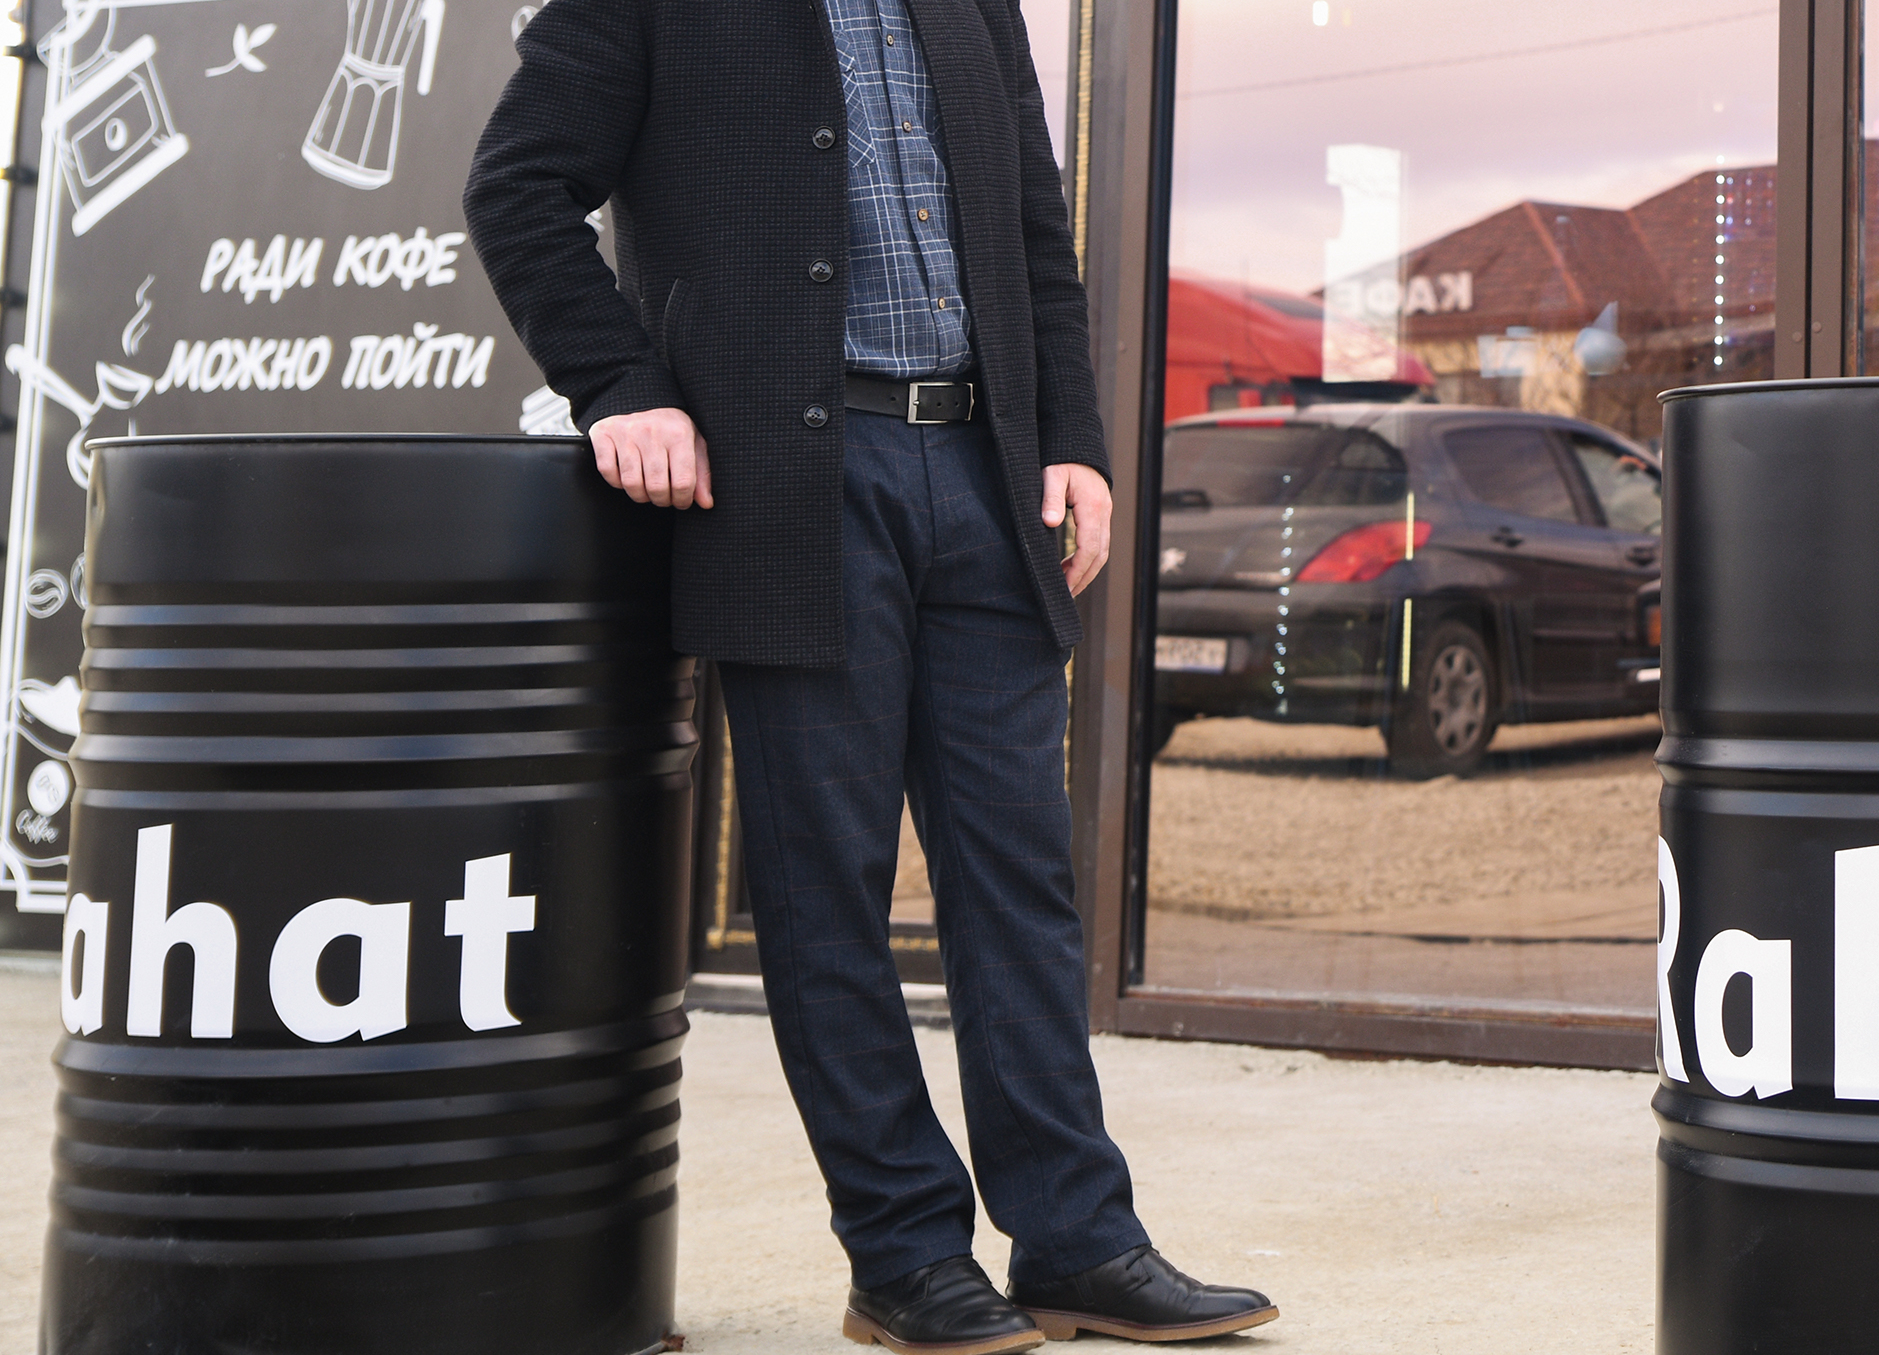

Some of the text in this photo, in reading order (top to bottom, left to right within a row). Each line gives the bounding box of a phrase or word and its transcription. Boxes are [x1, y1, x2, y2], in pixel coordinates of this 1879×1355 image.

[200, 227, 467, 304] РАДИ КОФЕ
[155, 321, 495, 395] МОЖНО ПОЙТИ
